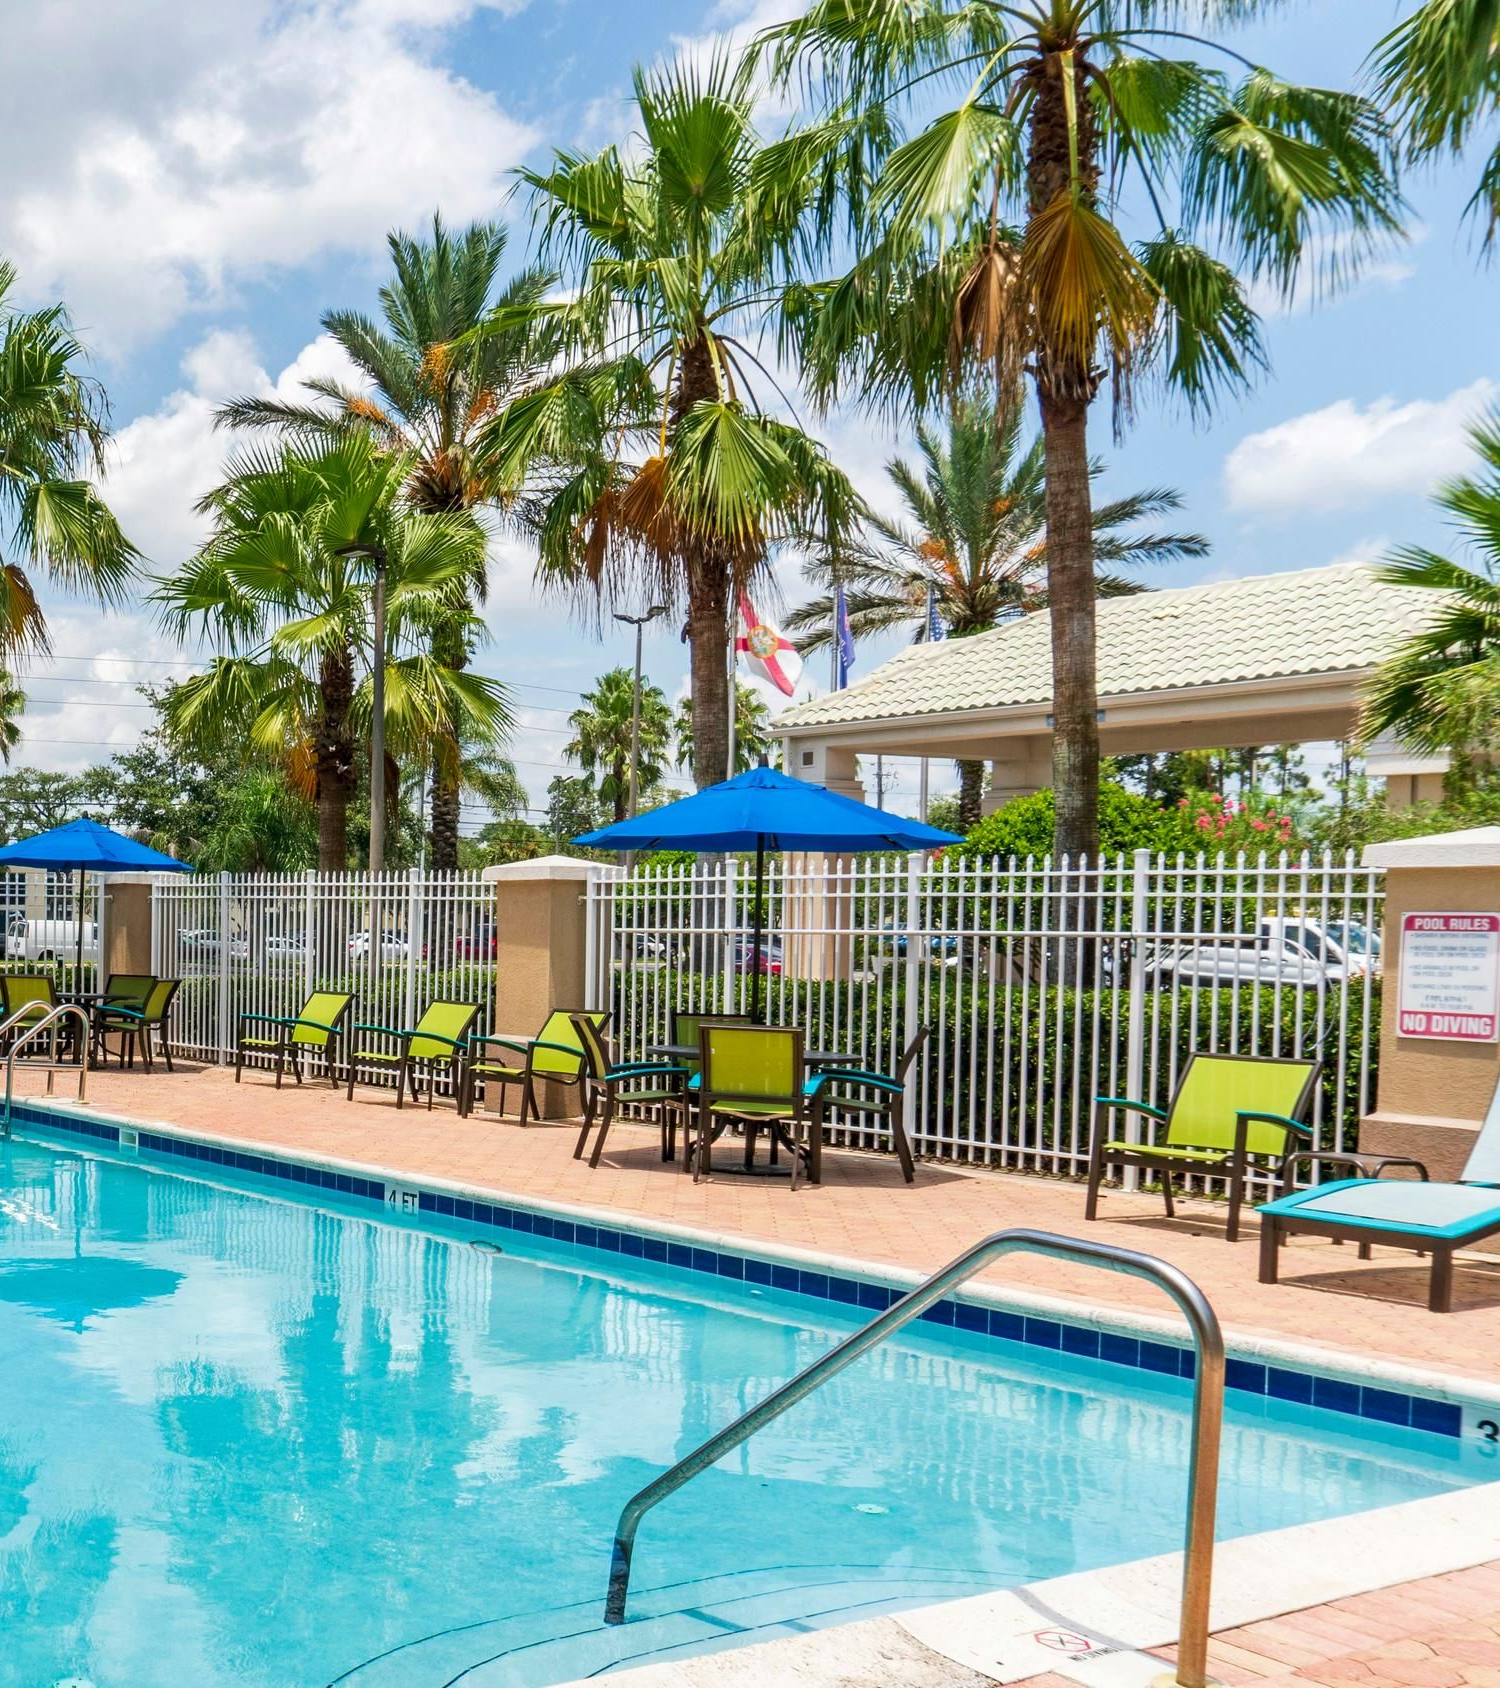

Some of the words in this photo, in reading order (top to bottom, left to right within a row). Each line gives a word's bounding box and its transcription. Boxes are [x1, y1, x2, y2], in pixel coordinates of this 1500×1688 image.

[1414, 918, 1447, 930] POOL
[1449, 918, 1491, 931] RULES
[1403, 1013, 1427, 1032] NO
[1431, 1015, 1492, 1036] DIVING
[1477, 1420, 1499, 1443] 3
